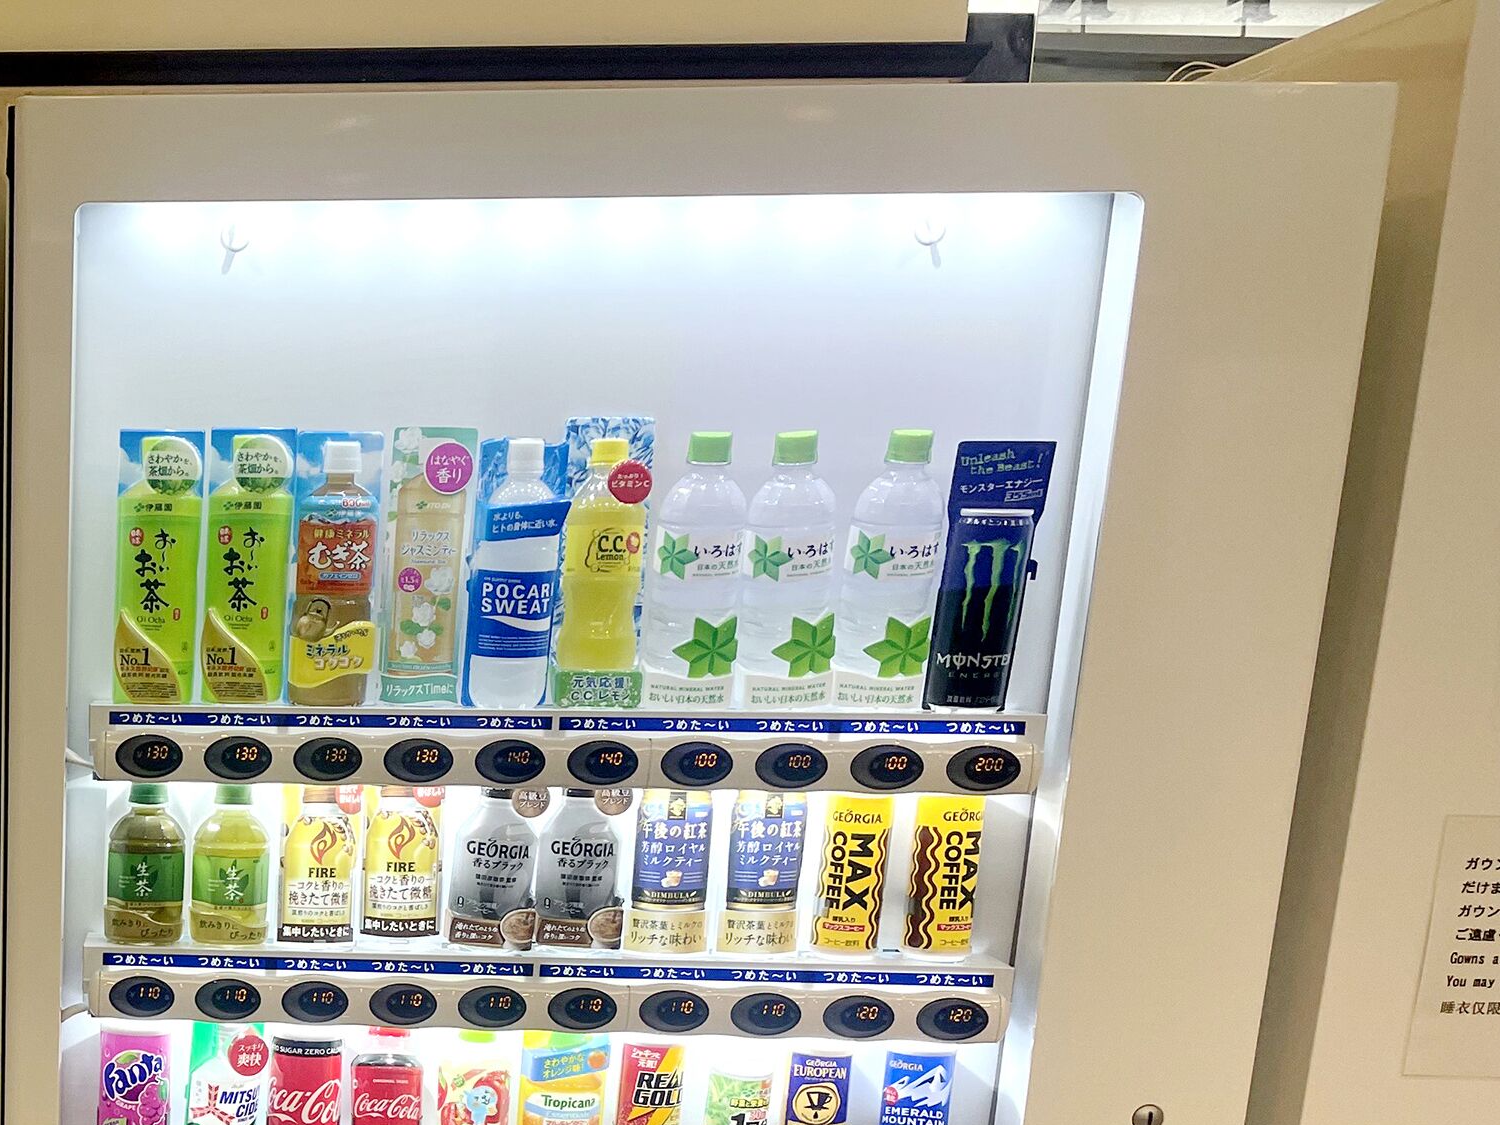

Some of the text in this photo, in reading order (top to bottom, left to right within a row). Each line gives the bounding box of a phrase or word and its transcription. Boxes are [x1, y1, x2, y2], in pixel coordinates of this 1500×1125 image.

[961, 448, 1016, 466] Unleash
[436, 468, 463, 484] 香り
[970, 465, 994, 475] the
[960, 478, 1043, 494] モンスターエナジー
[412, 531, 450, 542] リラックス
[308, 540, 371, 571] むぎ茶
[401, 545, 456, 556] ジャスミンティー
[595, 552, 624, 561] Lemon
[482, 582, 554, 599] POCARI
[481, 597, 550, 614] SWEAT
[235, 746, 257, 762] 130
[415, 749, 438, 764] 130
[599, 750, 622, 767] 140
[694, 752, 717, 768] 100
[975, 756, 1003, 773] 200
[833, 809, 883, 824] GEORGIA
[642, 821, 708, 839] 午後の紅茶
[467, 837, 530, 859] GEORGIA
[551, 836, 614, 857] GEORGIA
[387, 862, 415, 872] FIRE
[473, 859, 523, 871] 香るブラック
[558, 858, 609, 871] 香るブラック
[643, 856, 703, 867] ミルクティー
[740, 855, 797, 866] ミルクティー
[308, 867, 336, 878] FIRE
[826, 831, 848, 911] COFFEE
[842, 833, 876, 911] MAX
[939, 831, 964, 910] COFFEE
[136, 863, 152, 897] 生茶
[224, 866, 243, 901] 生茶
[651, 891, 691, 899] DIMBULA
[1457, 905, 1500, 918] ガウン
[364, 918, 434, 930] 集中したいときに
[283, 926, 350, 938] 集中したいときに
[1455, 928, 1500, 942] ご遠慮
[1450, 952, 1485, 965] Gowns
[1446, 975, 1495, 989] You may
[312, 990, 334, 1005] 110
[855, 1005, 878, 1020] 120
[280, 1046, 326, 1055] SUGAR ZERO
[237, 1054, 262, 1068] 爽快
[805, 1059, 837, 1067] GEORGIA
[890, 1060, 923, 1071] GEORGIA
[104, 1053, 163, 1099] Fanta
[793, 1065, 847, 1079] EUROPEAN
[355, 1093, 420, 1119] Coca-Cola
[541, 1095, 595, 1110] Tropicana
[885, 1106, 943, 1118] EMERALD
